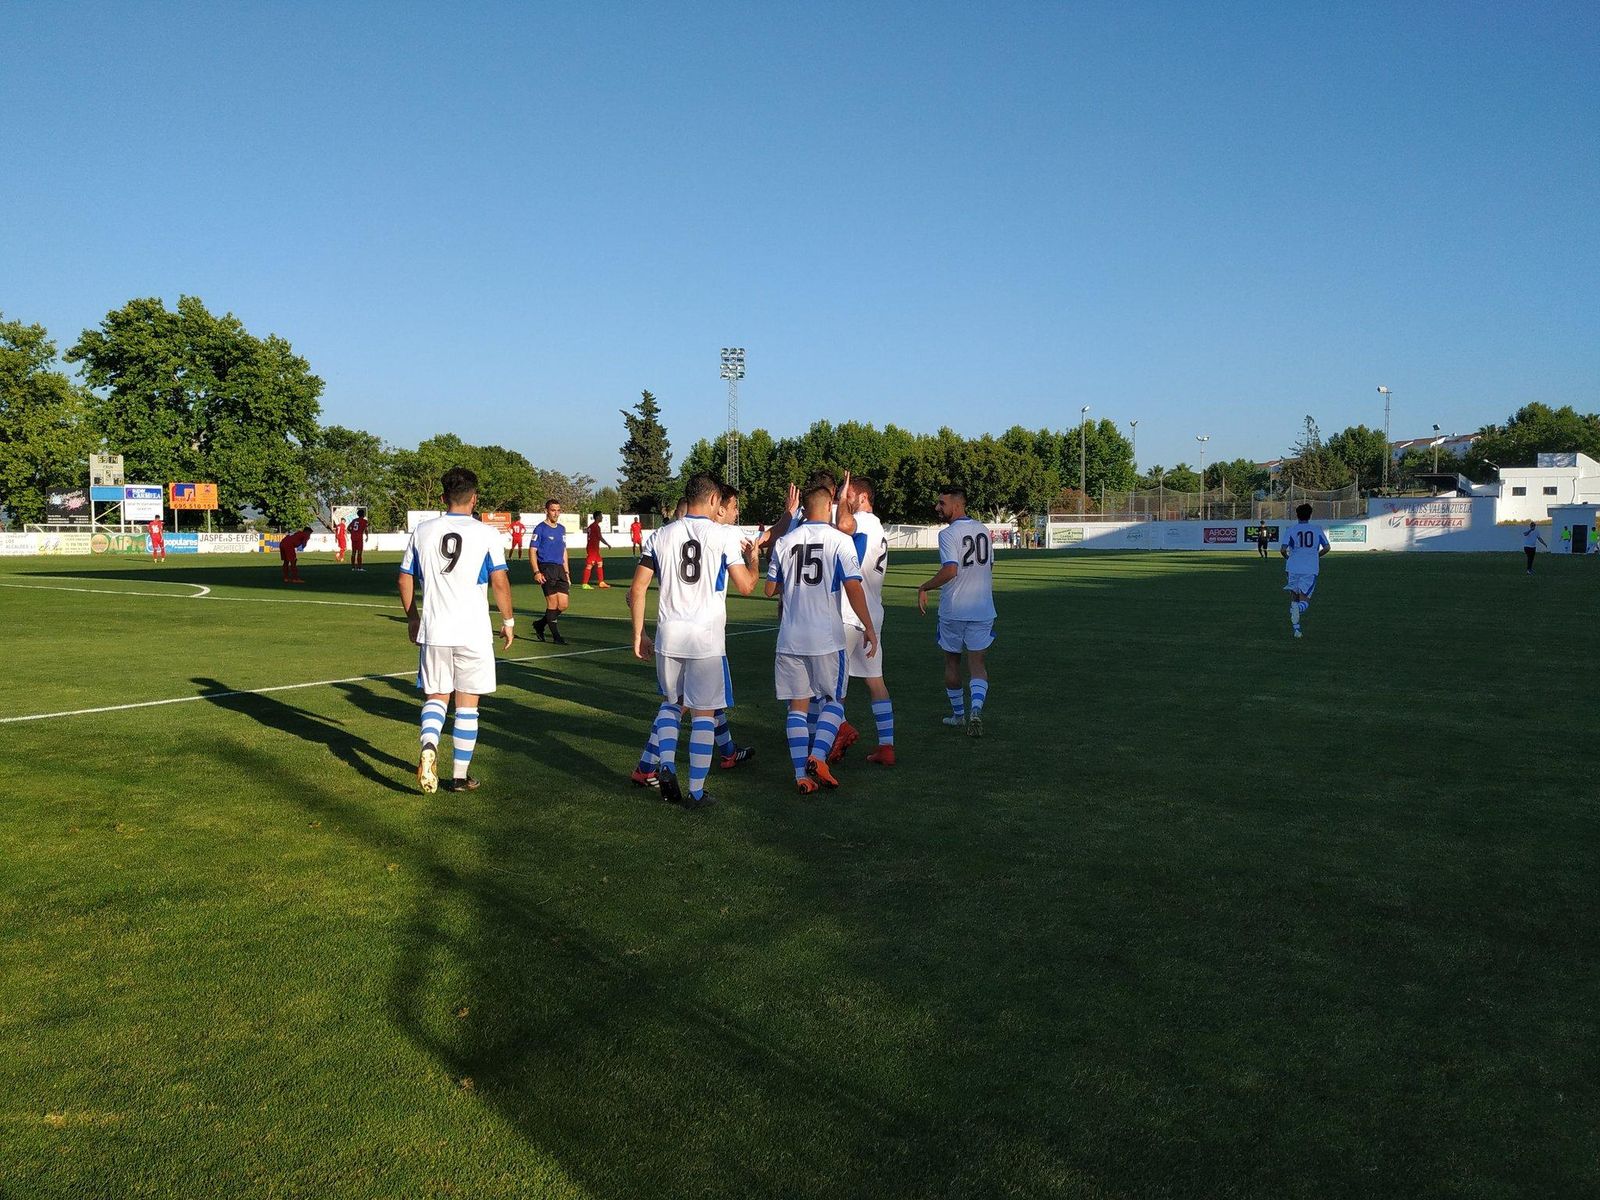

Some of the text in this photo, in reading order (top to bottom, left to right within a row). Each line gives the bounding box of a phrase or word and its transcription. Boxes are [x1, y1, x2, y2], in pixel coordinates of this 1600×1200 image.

[1297, 531, 1314, 547] 10
[1405, 517, 1463, 527] VALENZUELA
[440, 532, 463, 575] 9
[679, 539, 702, 585] 8
[790, 543, 824, 586] 15
[961, 532, 990, 567] 20
